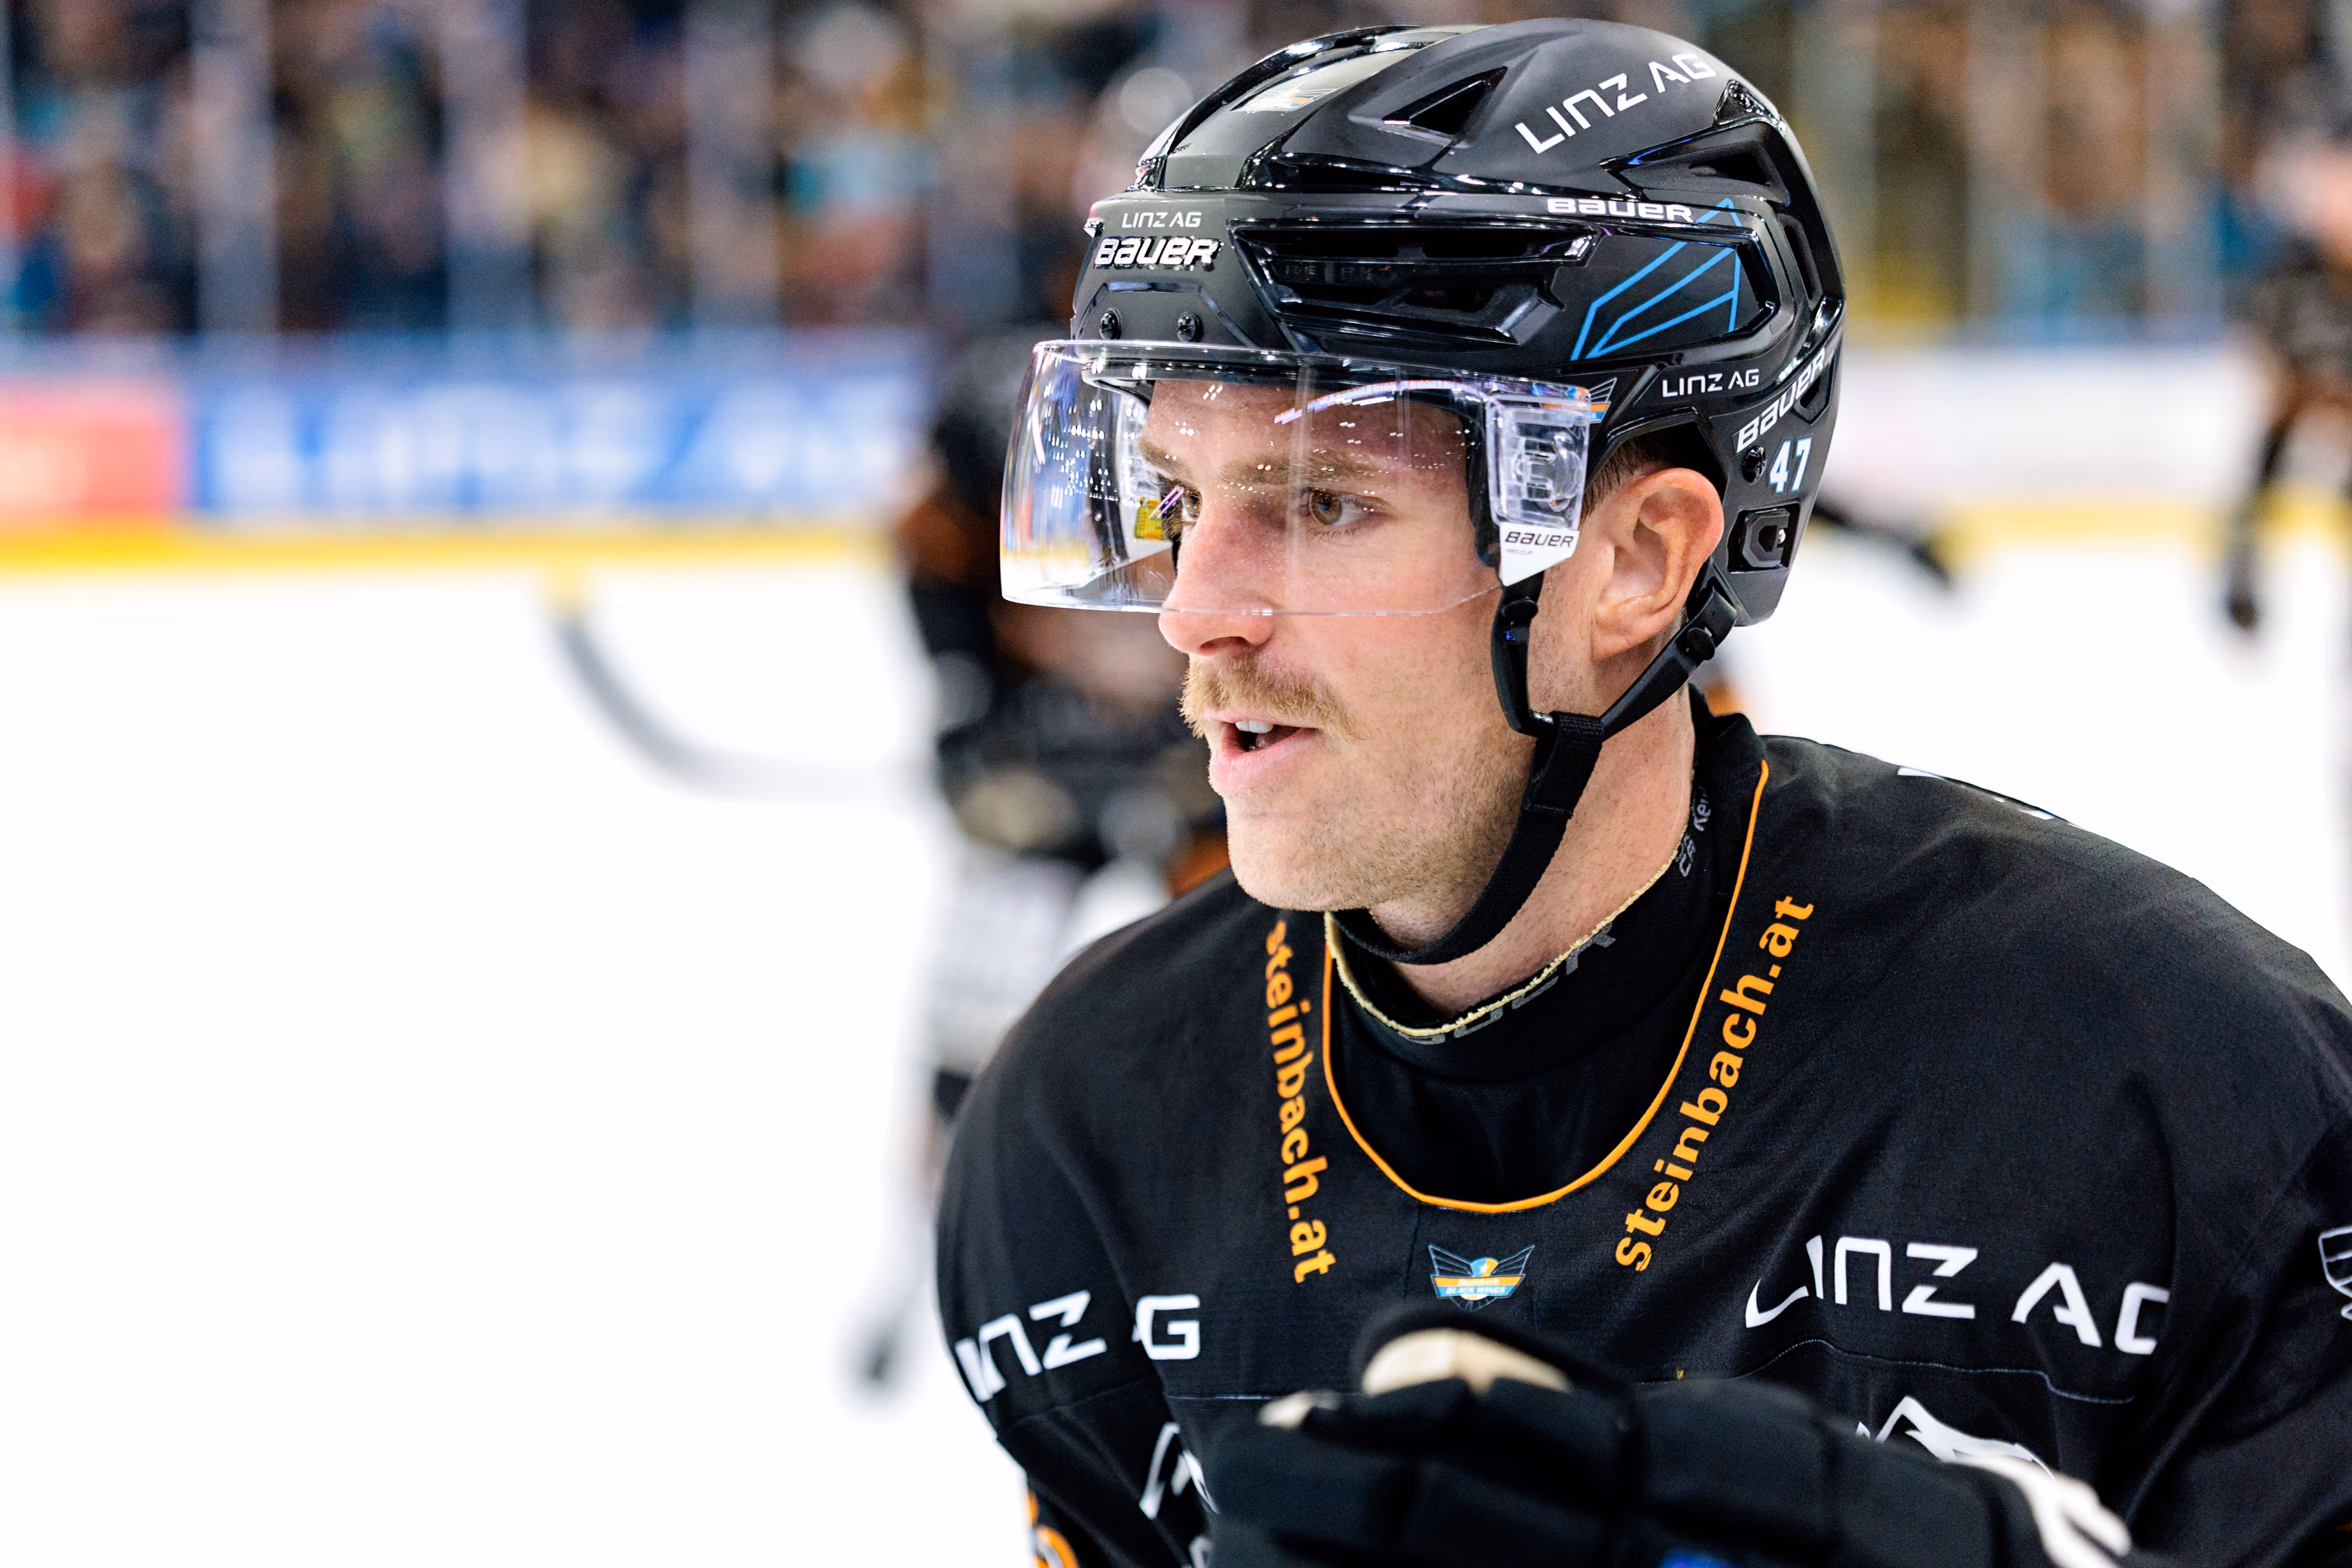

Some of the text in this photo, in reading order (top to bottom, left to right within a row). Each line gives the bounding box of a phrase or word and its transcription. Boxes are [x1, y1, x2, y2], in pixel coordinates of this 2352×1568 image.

[1515, 53, 1716, 154] LINZ AG
[1122, 212, 1202, 228] LINZ AG
[1547, 198, 1695, 223] BAUER
[1094, 236, 1220, 266] BAUER
[1662, 368, 1759, 397] LINZ AG
[1736, 347, 1825, 454] BAUER
[1769, 437, 1812, 494] 47
[1504, 531, 1574, 548] BAUER
[1266, 920, 1336, 1283] steinbach.at
[1615, 895, 1814, 1272] steinbach.at
[1745, 1234, 1978, 1328] LINZ
[954, 1289, 1200, 1402] INZ G
